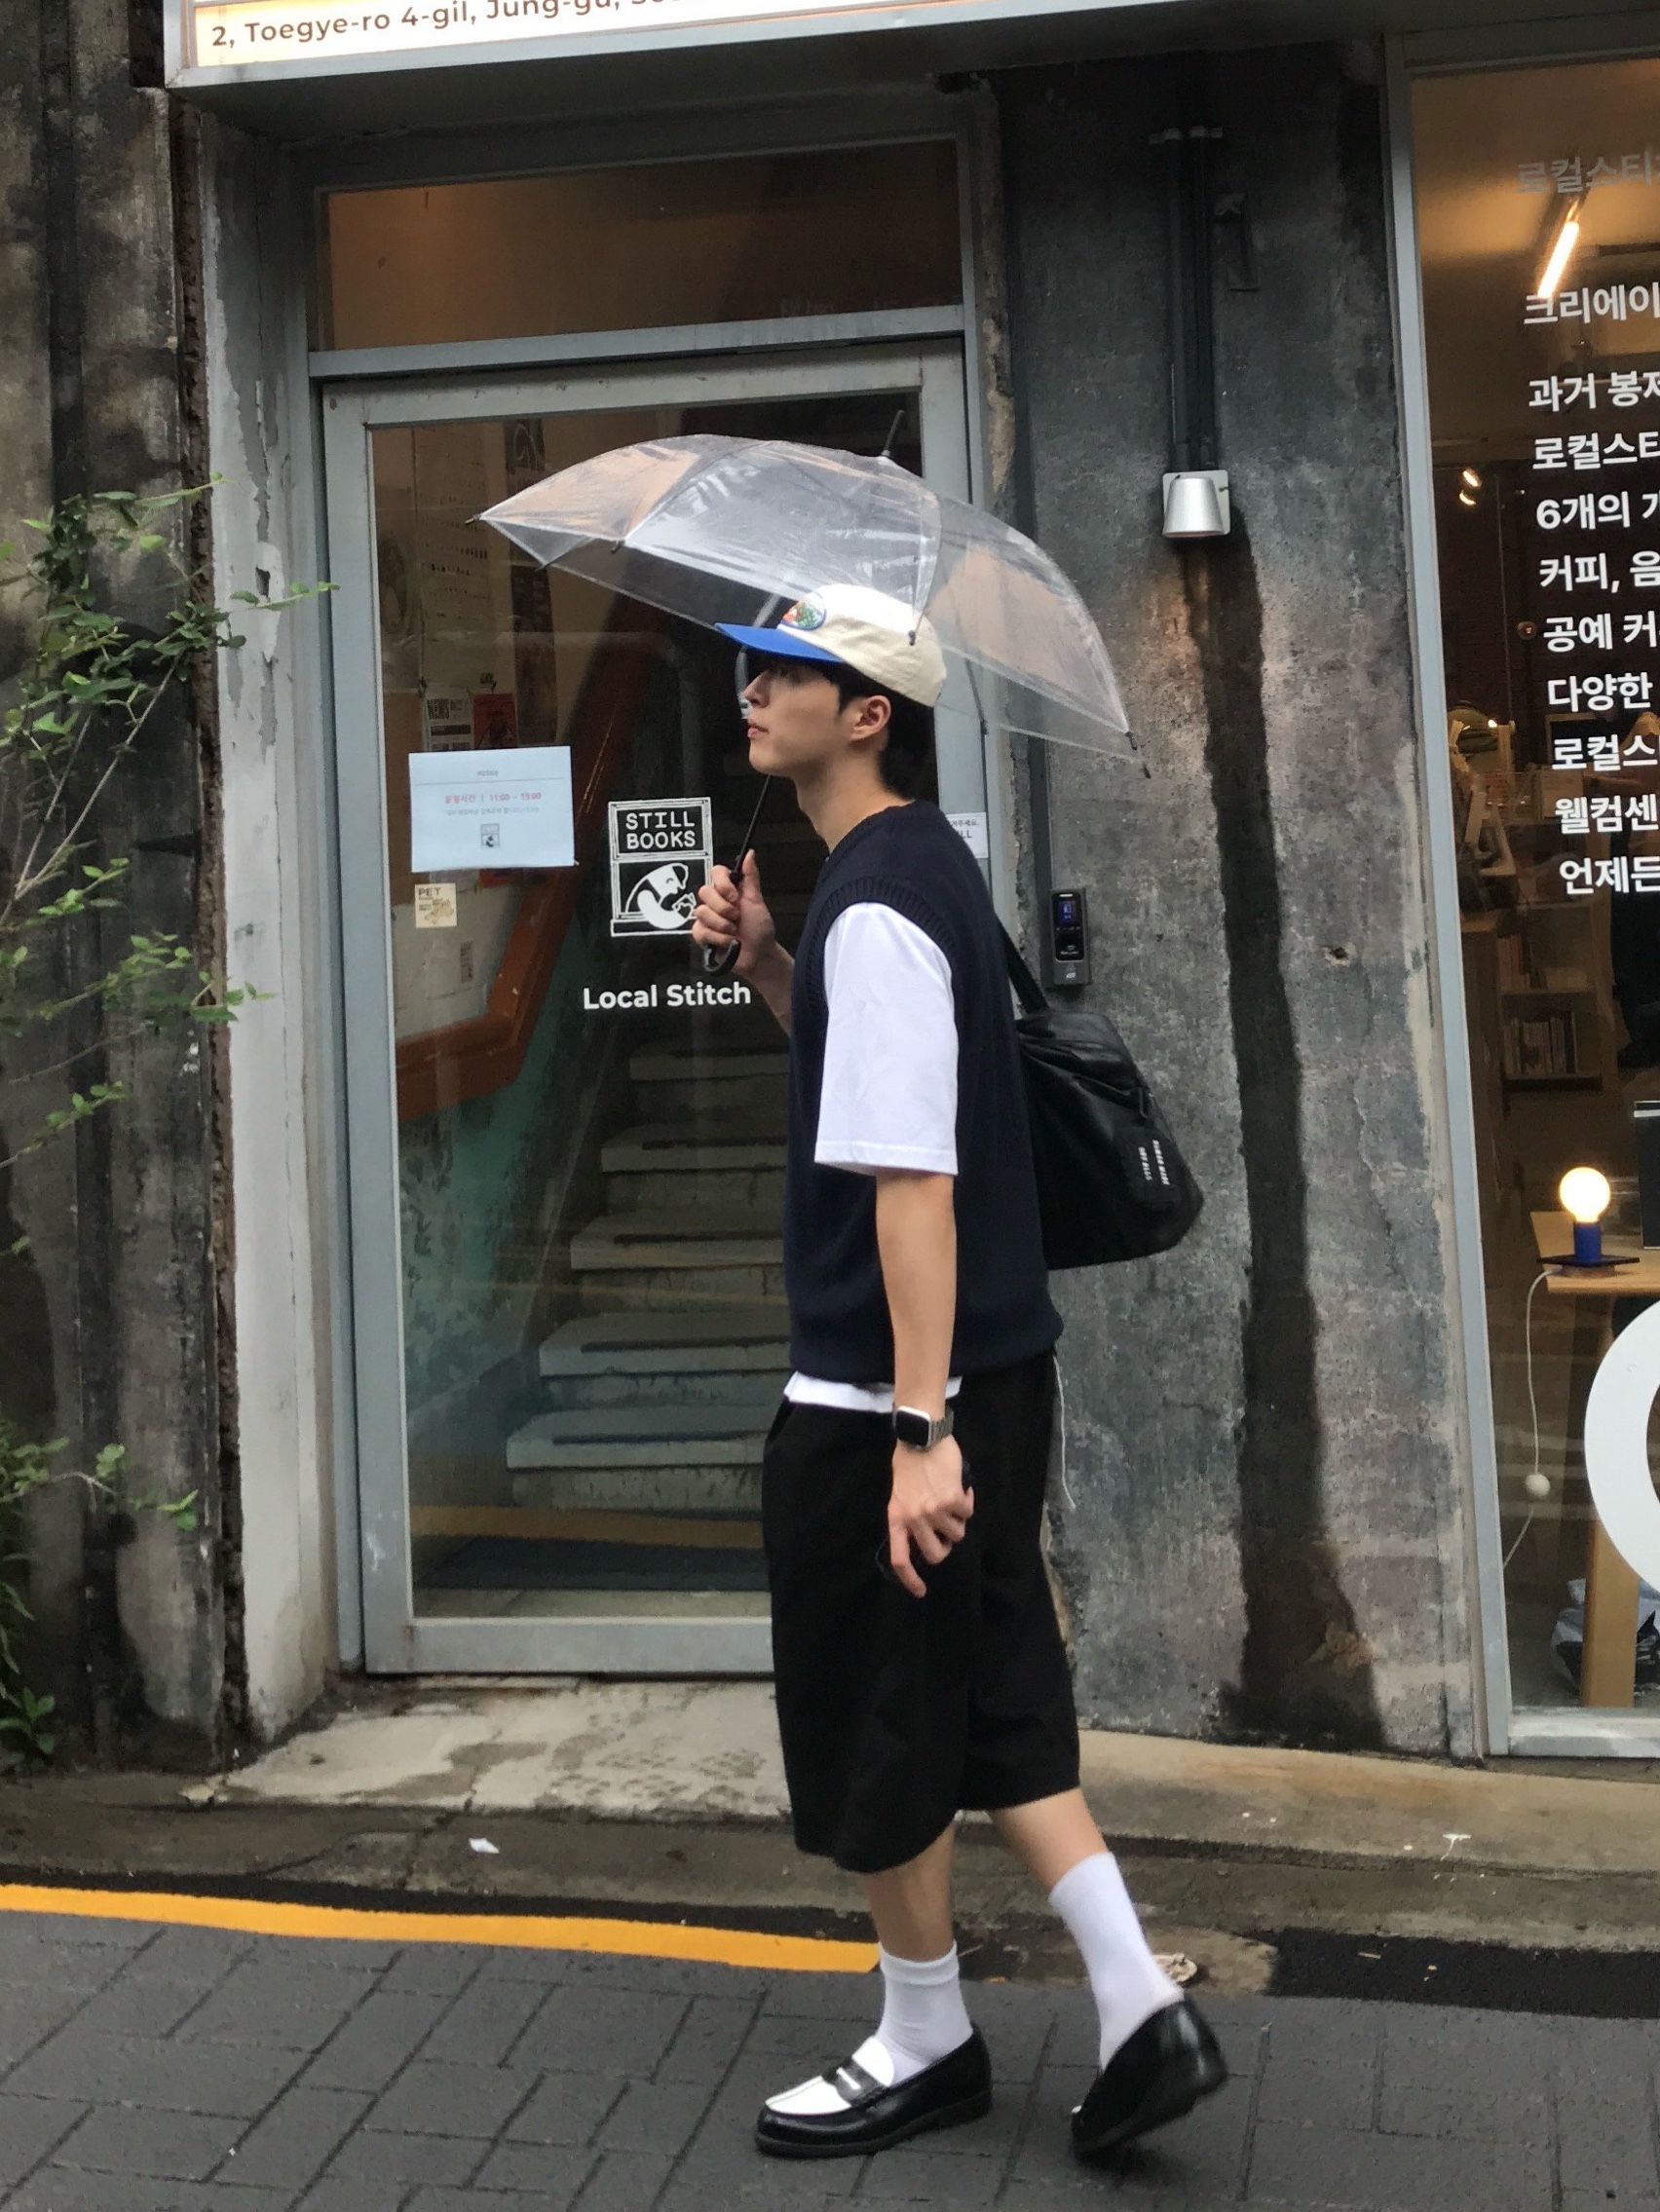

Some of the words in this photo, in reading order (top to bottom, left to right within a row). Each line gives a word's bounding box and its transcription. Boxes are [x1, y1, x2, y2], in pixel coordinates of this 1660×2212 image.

[212, 25, 235, 49] 2,
[245, 14, 390, 43] Toegye-ro
[401, 1, 476, 30] 4-gil,
[1518, 148, 1660, 194] 로컬스티
[1524, 282, 1660, 324] 크리에이
[1528, 374, 1596, 412] 과거
[1536, 491, 1631, 530] 6개의
[1540, 552, 1620, 593] 커피,
[1630, 550, 1660, 587] 음
[1544, 614, 1613, 653] 공예
[1623, 610, 1660, 648] 커
[1548, 672, 1653, 712] 다양한
[1552, 734, 1660, 771] 로컬스
[625, 810, 695, 830] STILL
[1556, 794, 1659, 835] 웰컴센
[626, 830, 696, 849] BOOKS
[418, 886, 441, 896] PET
[1560, 856, 1660, 894] 언제든
[584, 985, 658, 1010] Local
[666, 981, 751, 1006] Stitch
